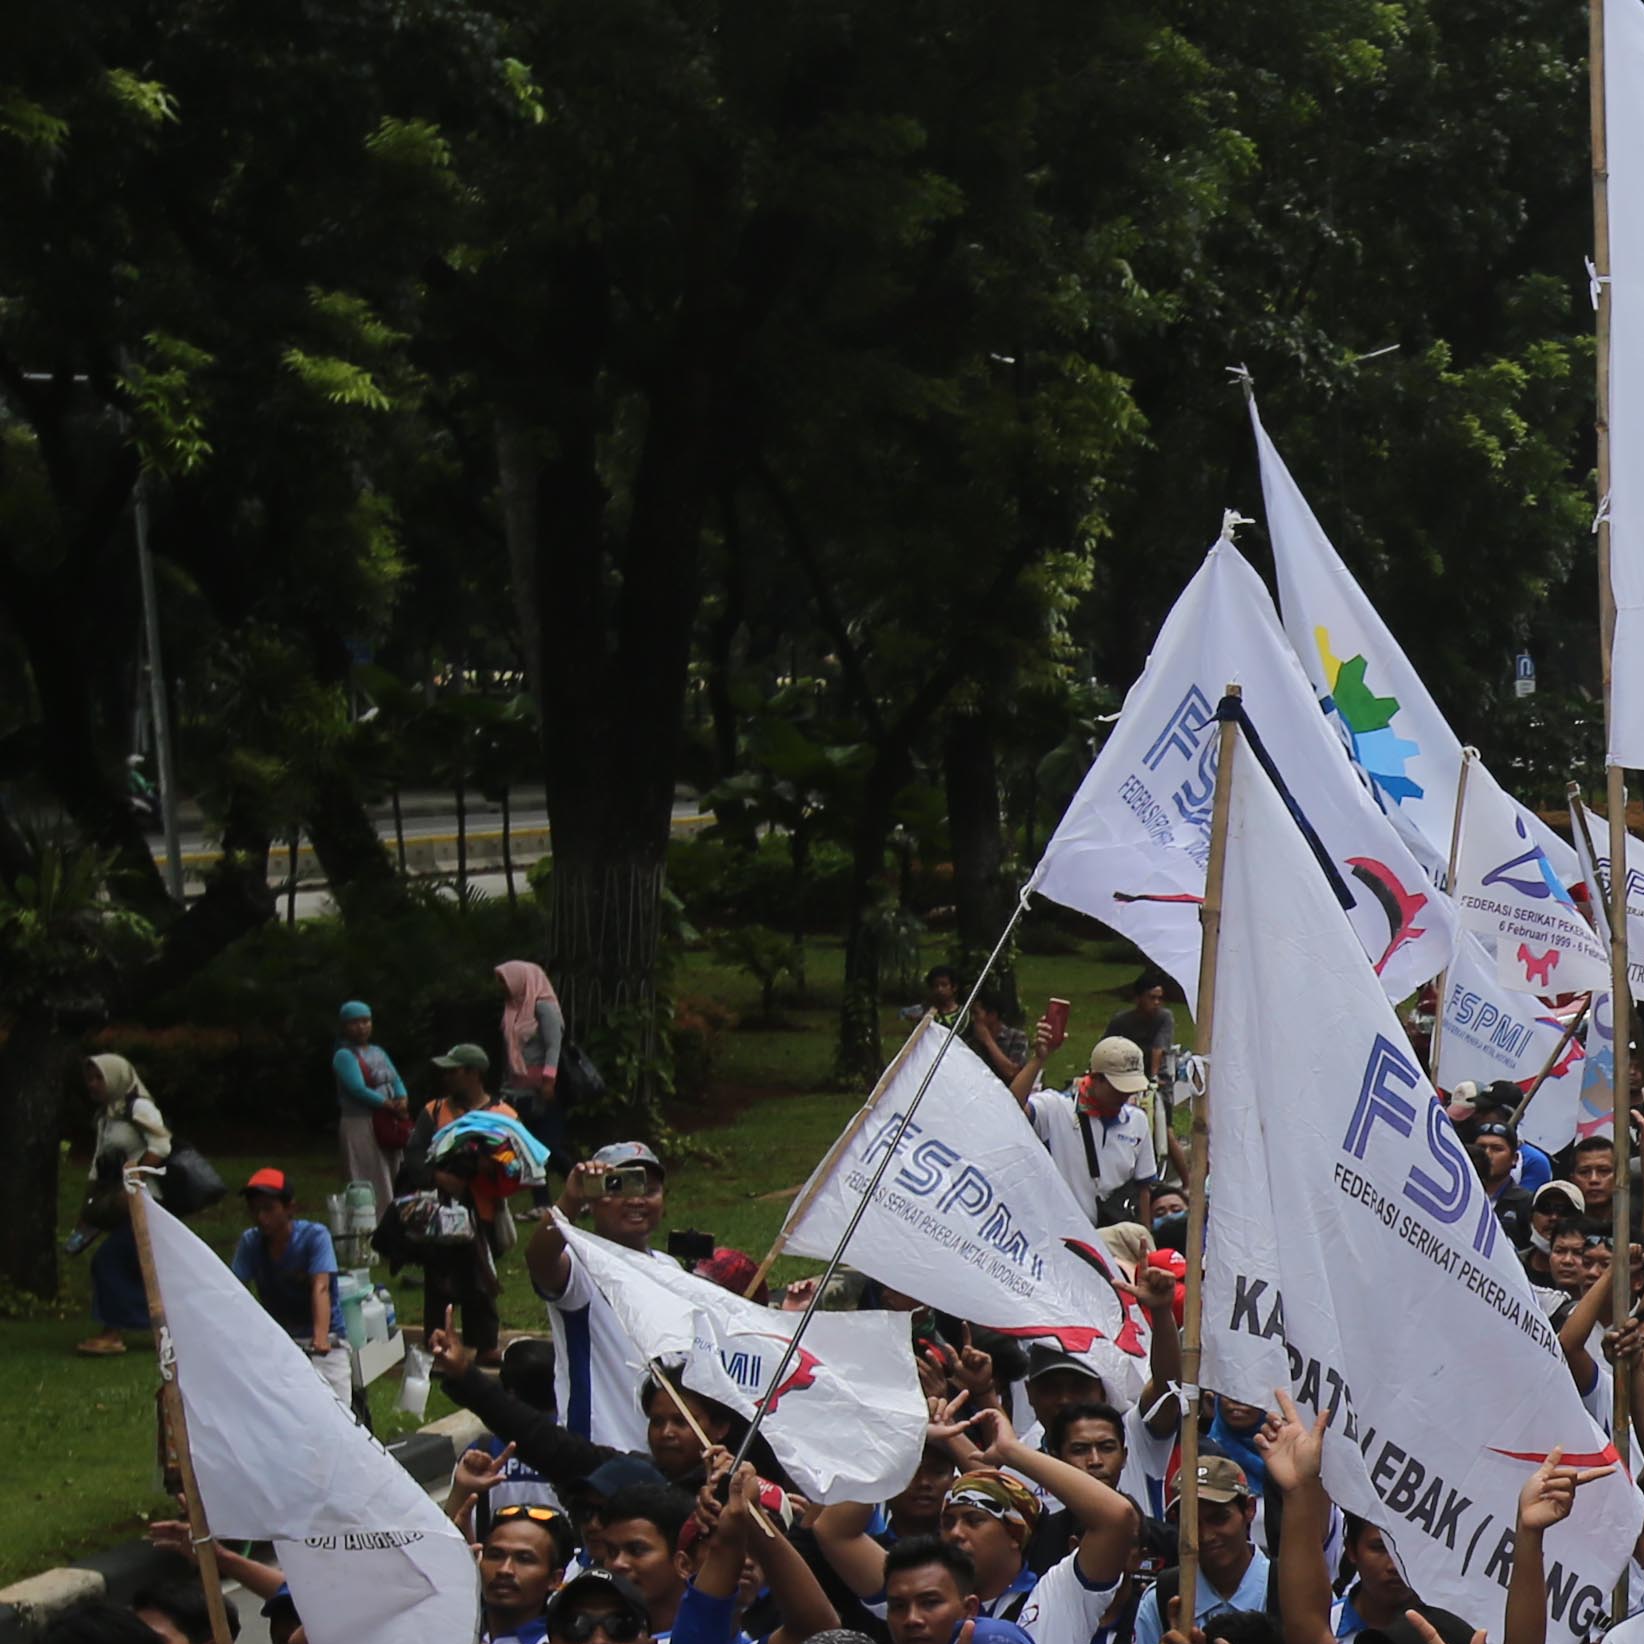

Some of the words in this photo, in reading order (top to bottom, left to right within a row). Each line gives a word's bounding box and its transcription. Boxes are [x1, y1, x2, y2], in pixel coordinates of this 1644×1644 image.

[1461, 895, 1513, 919] FEDERASI
[1513, 907, 1557, 930] SERIKAT
[884, 1193, 924, 1228] SERIKAT
[921, 1215, 960, 1251] PEKERJA
[960, 1239, 987, 1271] METAL
[987, 1257, 1036, 1298] INDONESIA
[1333, 1161, 1400, 1231] FEDERASI
[1399, 1214, 1457, 1276] SERIKAT
[1458, 1259, 1522, 1322] PEKERJA
[1521, 1307, 1558, 1352] METAL
